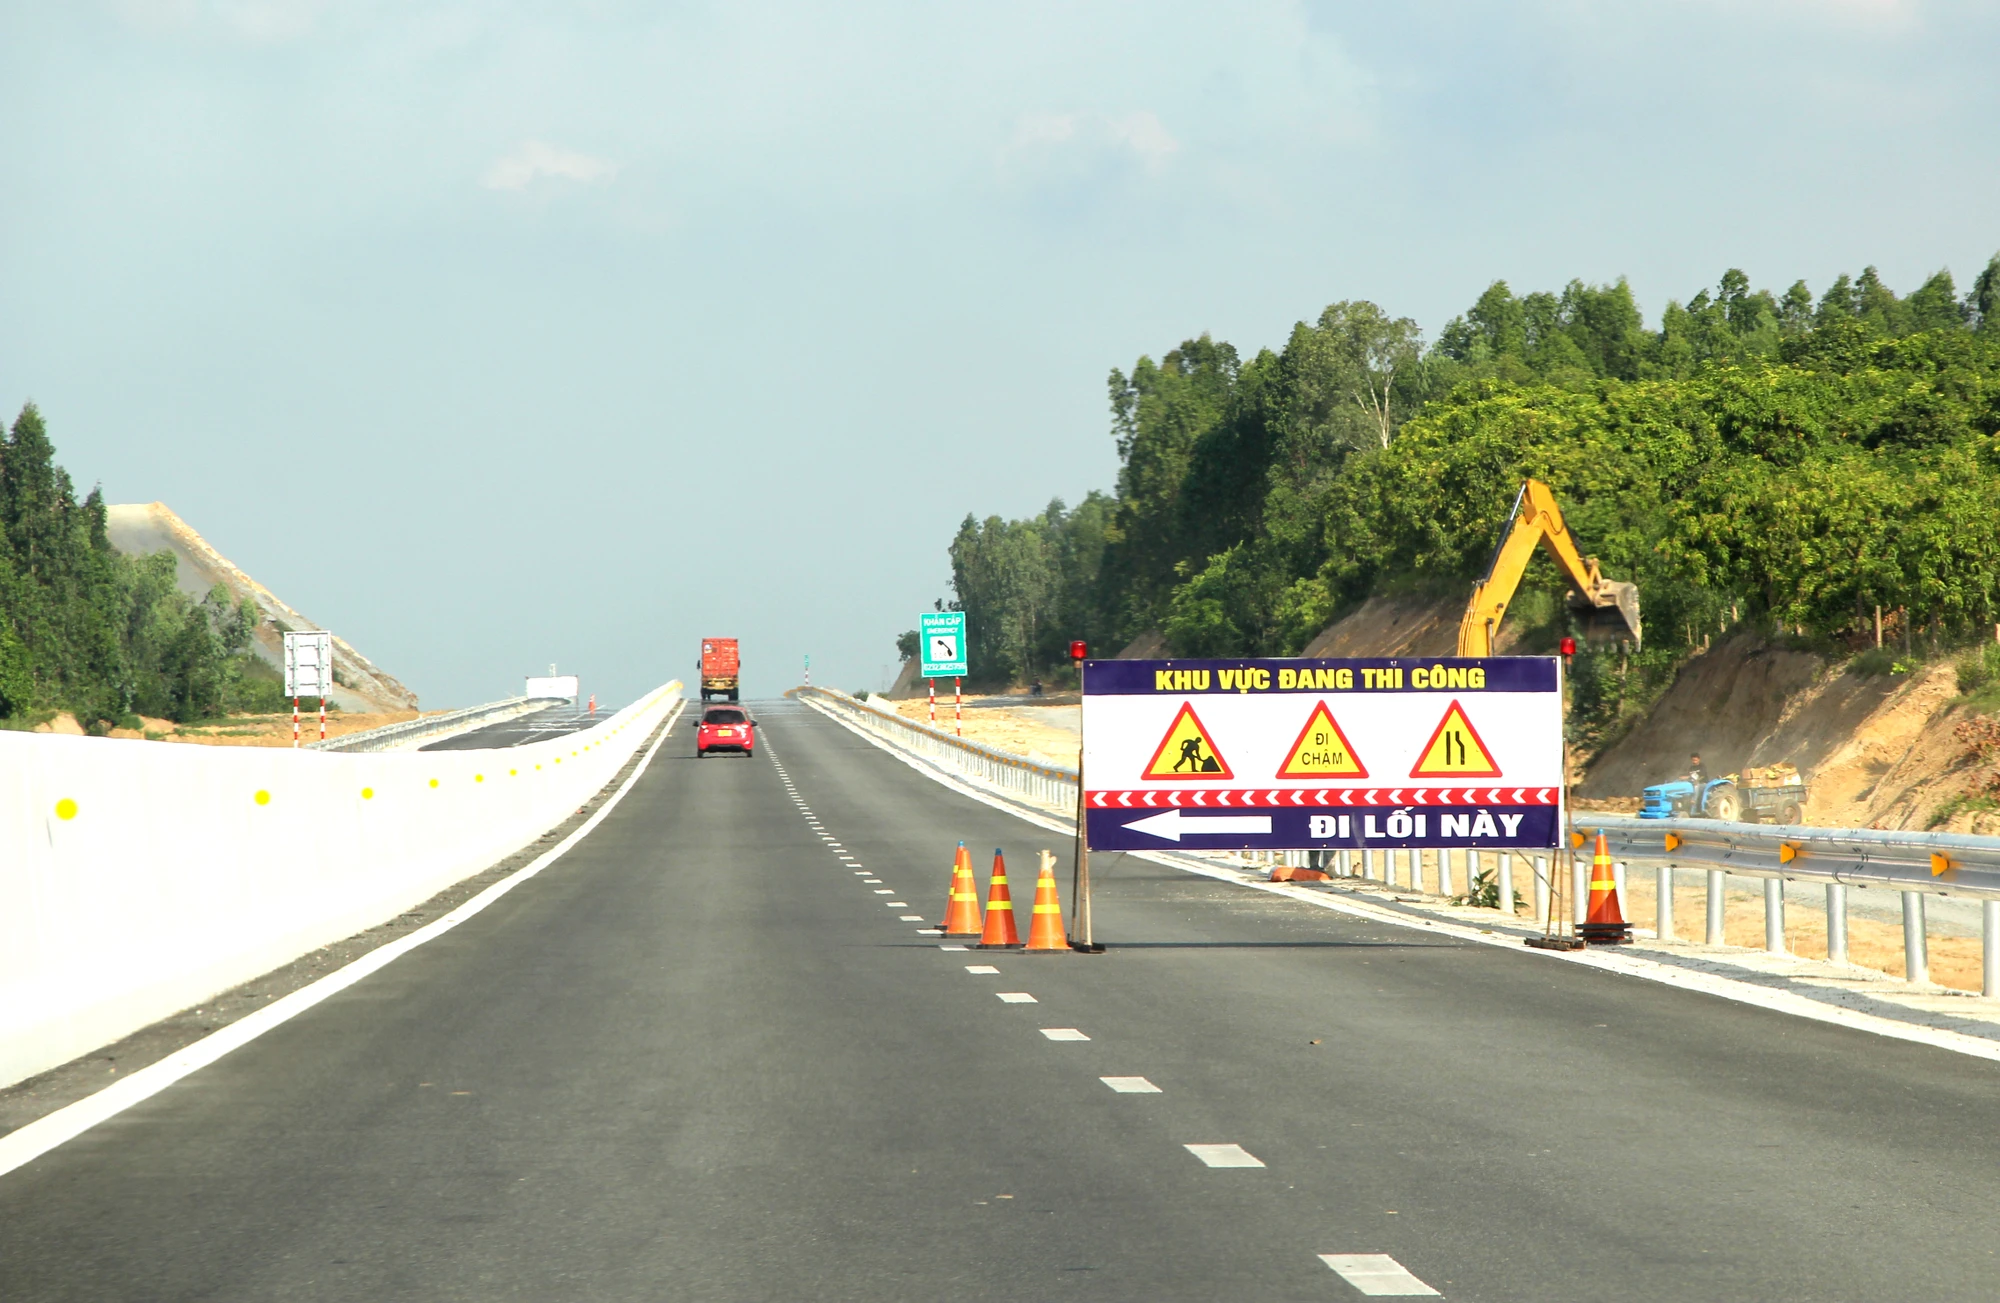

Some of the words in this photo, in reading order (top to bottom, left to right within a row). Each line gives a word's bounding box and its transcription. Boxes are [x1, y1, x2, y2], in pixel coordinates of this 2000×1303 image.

[1155, 670, 1210, 690] KHU
[1218, 668, 1271, 694] VỰC
[1278, 669, 1354, 689] ĐANG
[1361, 669, 1403, 689] THI
[1412, 664, 1486, 689] CÔNG
[1315, 732, 1329, 745] ĐI
[1302, 748, 1343, 768] CHẬM
[1309, 814, 1350, 838] ĐI
[1364, 806, 1427, 838] LỐI
[1441, 809, 1524, 838] NÀY
